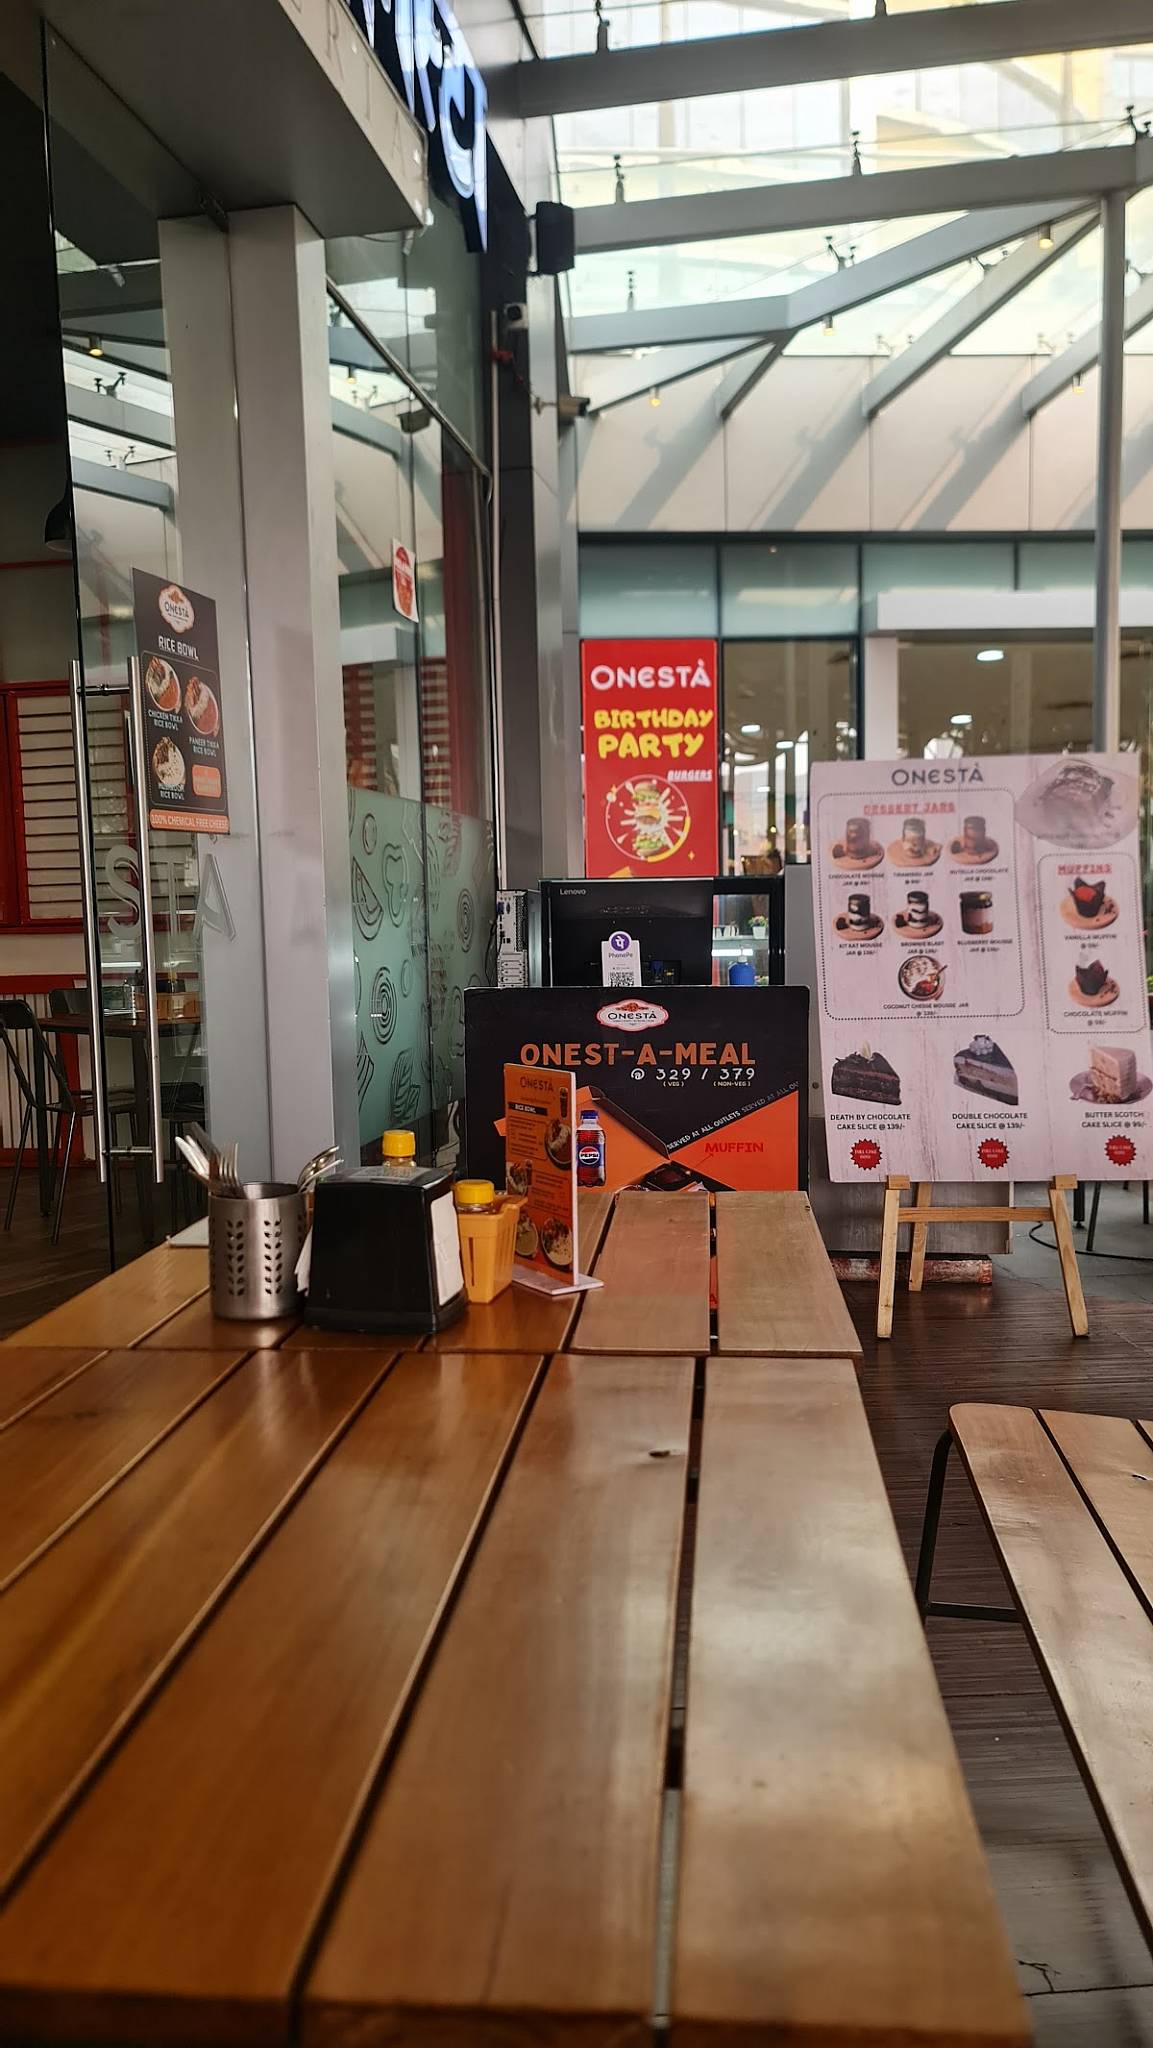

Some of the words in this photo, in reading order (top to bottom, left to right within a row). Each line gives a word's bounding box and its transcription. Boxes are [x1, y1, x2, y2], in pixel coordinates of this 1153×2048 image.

[158, 635, 175, 653] RICE
[177, 641, 199, 660] BOWL
[148, 709, 169, 721] CHICKEN
[593, 708, 714, 729] BIRTHDAY
[154, 718, 164, 728] RICE
[164, 720, 179, 731] BOWL
[193, 745, 203, 755] RICE
[204, 747, 217, 757] BOWL
[598, 731, 705, 760] PARTY
[667, 769, 713, 782] BURGERS
[160, 790, 171, 799] RICE
[171, 791, 185, 800] BOWL
[924, 802, 956, 813] JARS
[168, 815, 195, 827] CHEMICAL
[1057, 864, 1112, 875] MUFFINS
[560, 888, 587, 896] Lenovo
[520, 1042, 756, 1066] ONEST-A-MEAL
[656, 1067, 691, 1081] 329
[700, 1068, 708, 1080] /
[719, 1067, 755, 1080] 379
[666, 1133, 691, 1150] SERVED
[691, 1130, 700, 1138] AT
[701, 1124, 713, 1133] ALL
[713, 1110, 741, 1127] OUTLETS
[741, 1098, 766, 1113] SERVED
[776, 1087, 788, 1097] ALL
[867, 1113, 911, 1121] CHOCOLATE
[704, 1142, 764, 1153] MUFFIN
